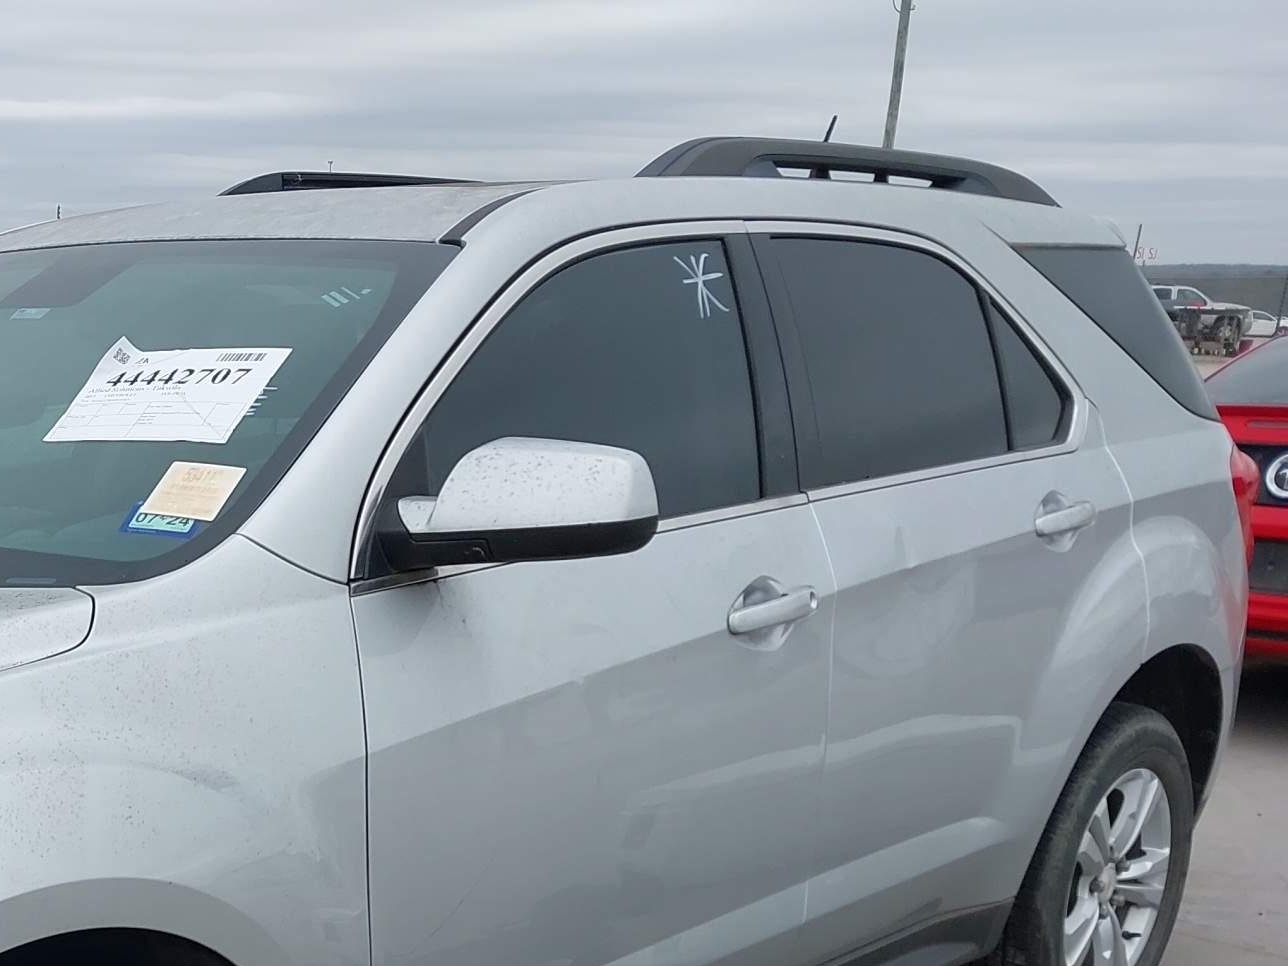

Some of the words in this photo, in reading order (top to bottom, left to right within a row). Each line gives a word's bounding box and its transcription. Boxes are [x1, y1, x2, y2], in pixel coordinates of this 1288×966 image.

[106, 368, 252, 387] 44442707
[135, 512, 158, 524] 07
[166, 517, 189, 528] 24
